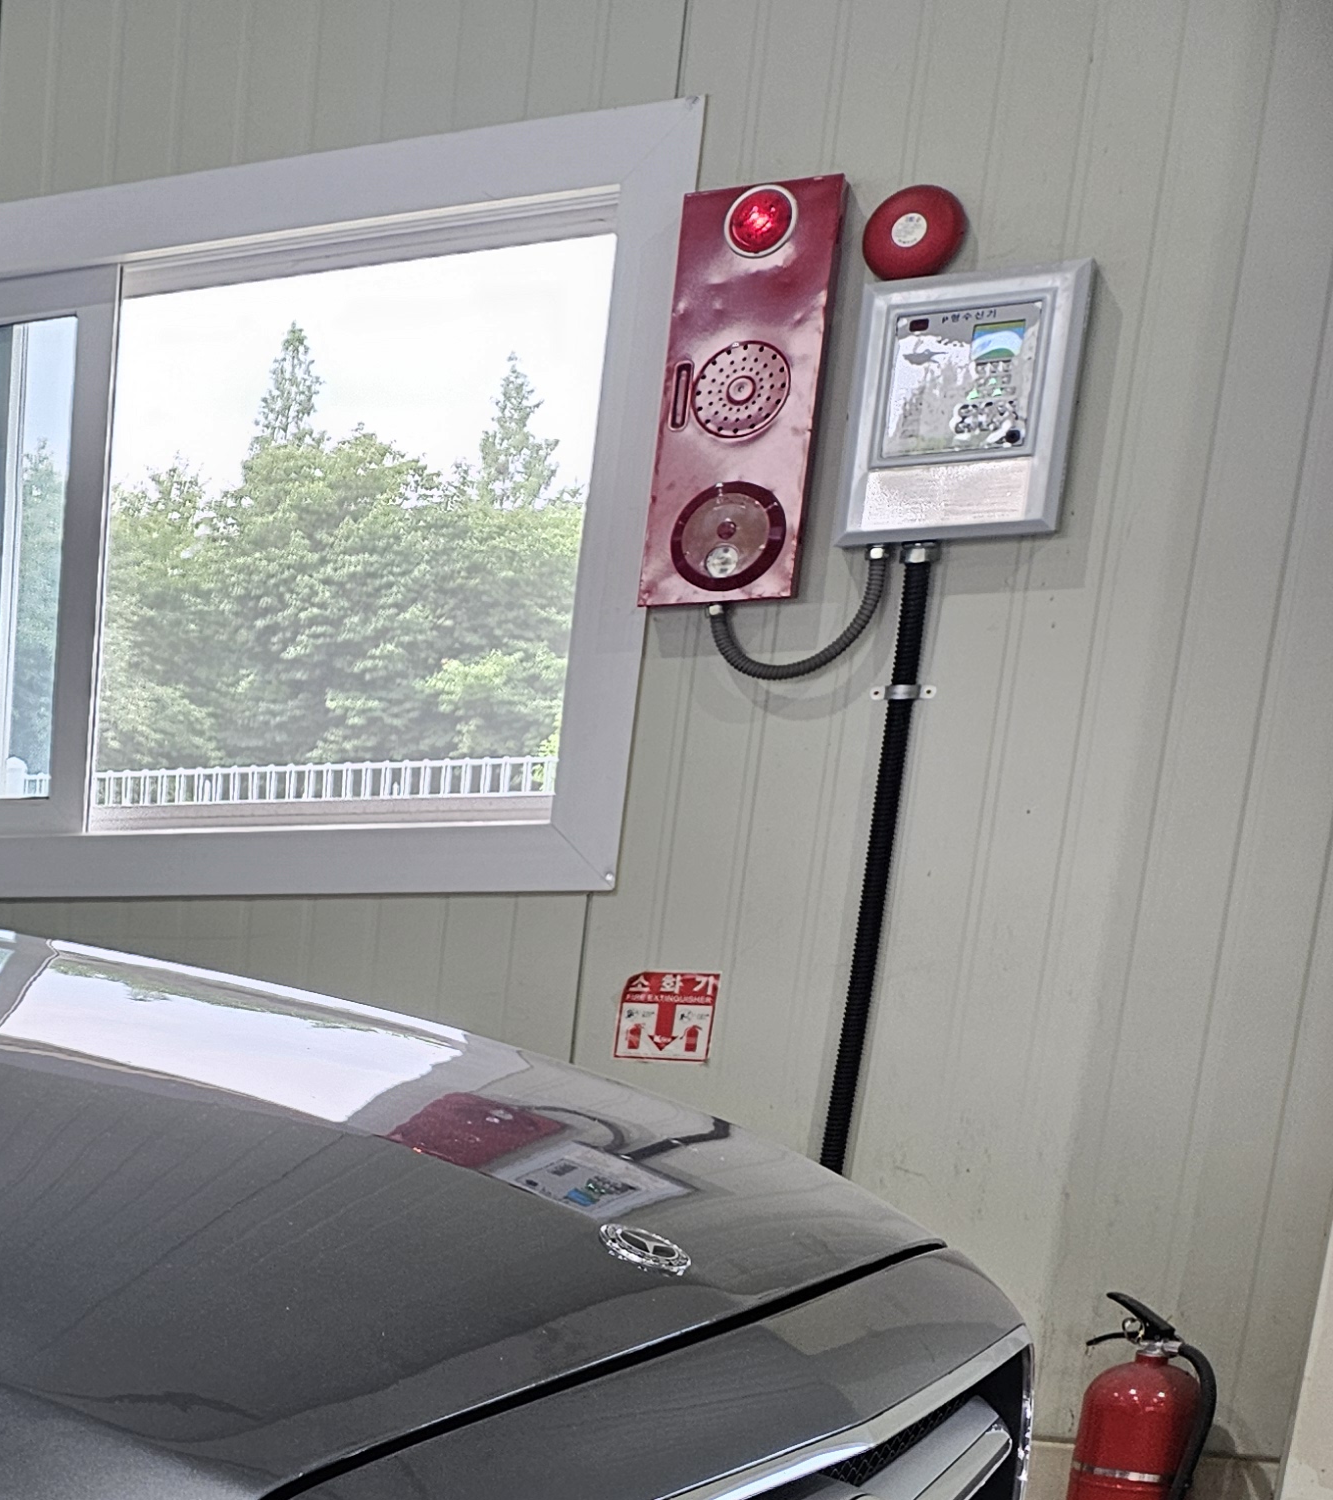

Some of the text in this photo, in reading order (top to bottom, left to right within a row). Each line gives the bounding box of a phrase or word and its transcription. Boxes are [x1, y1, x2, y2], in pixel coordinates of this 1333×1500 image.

[628, 974, 715, 996] 소화기
[625, 993, 713, 1004] FIRE EXTINGUISHER
